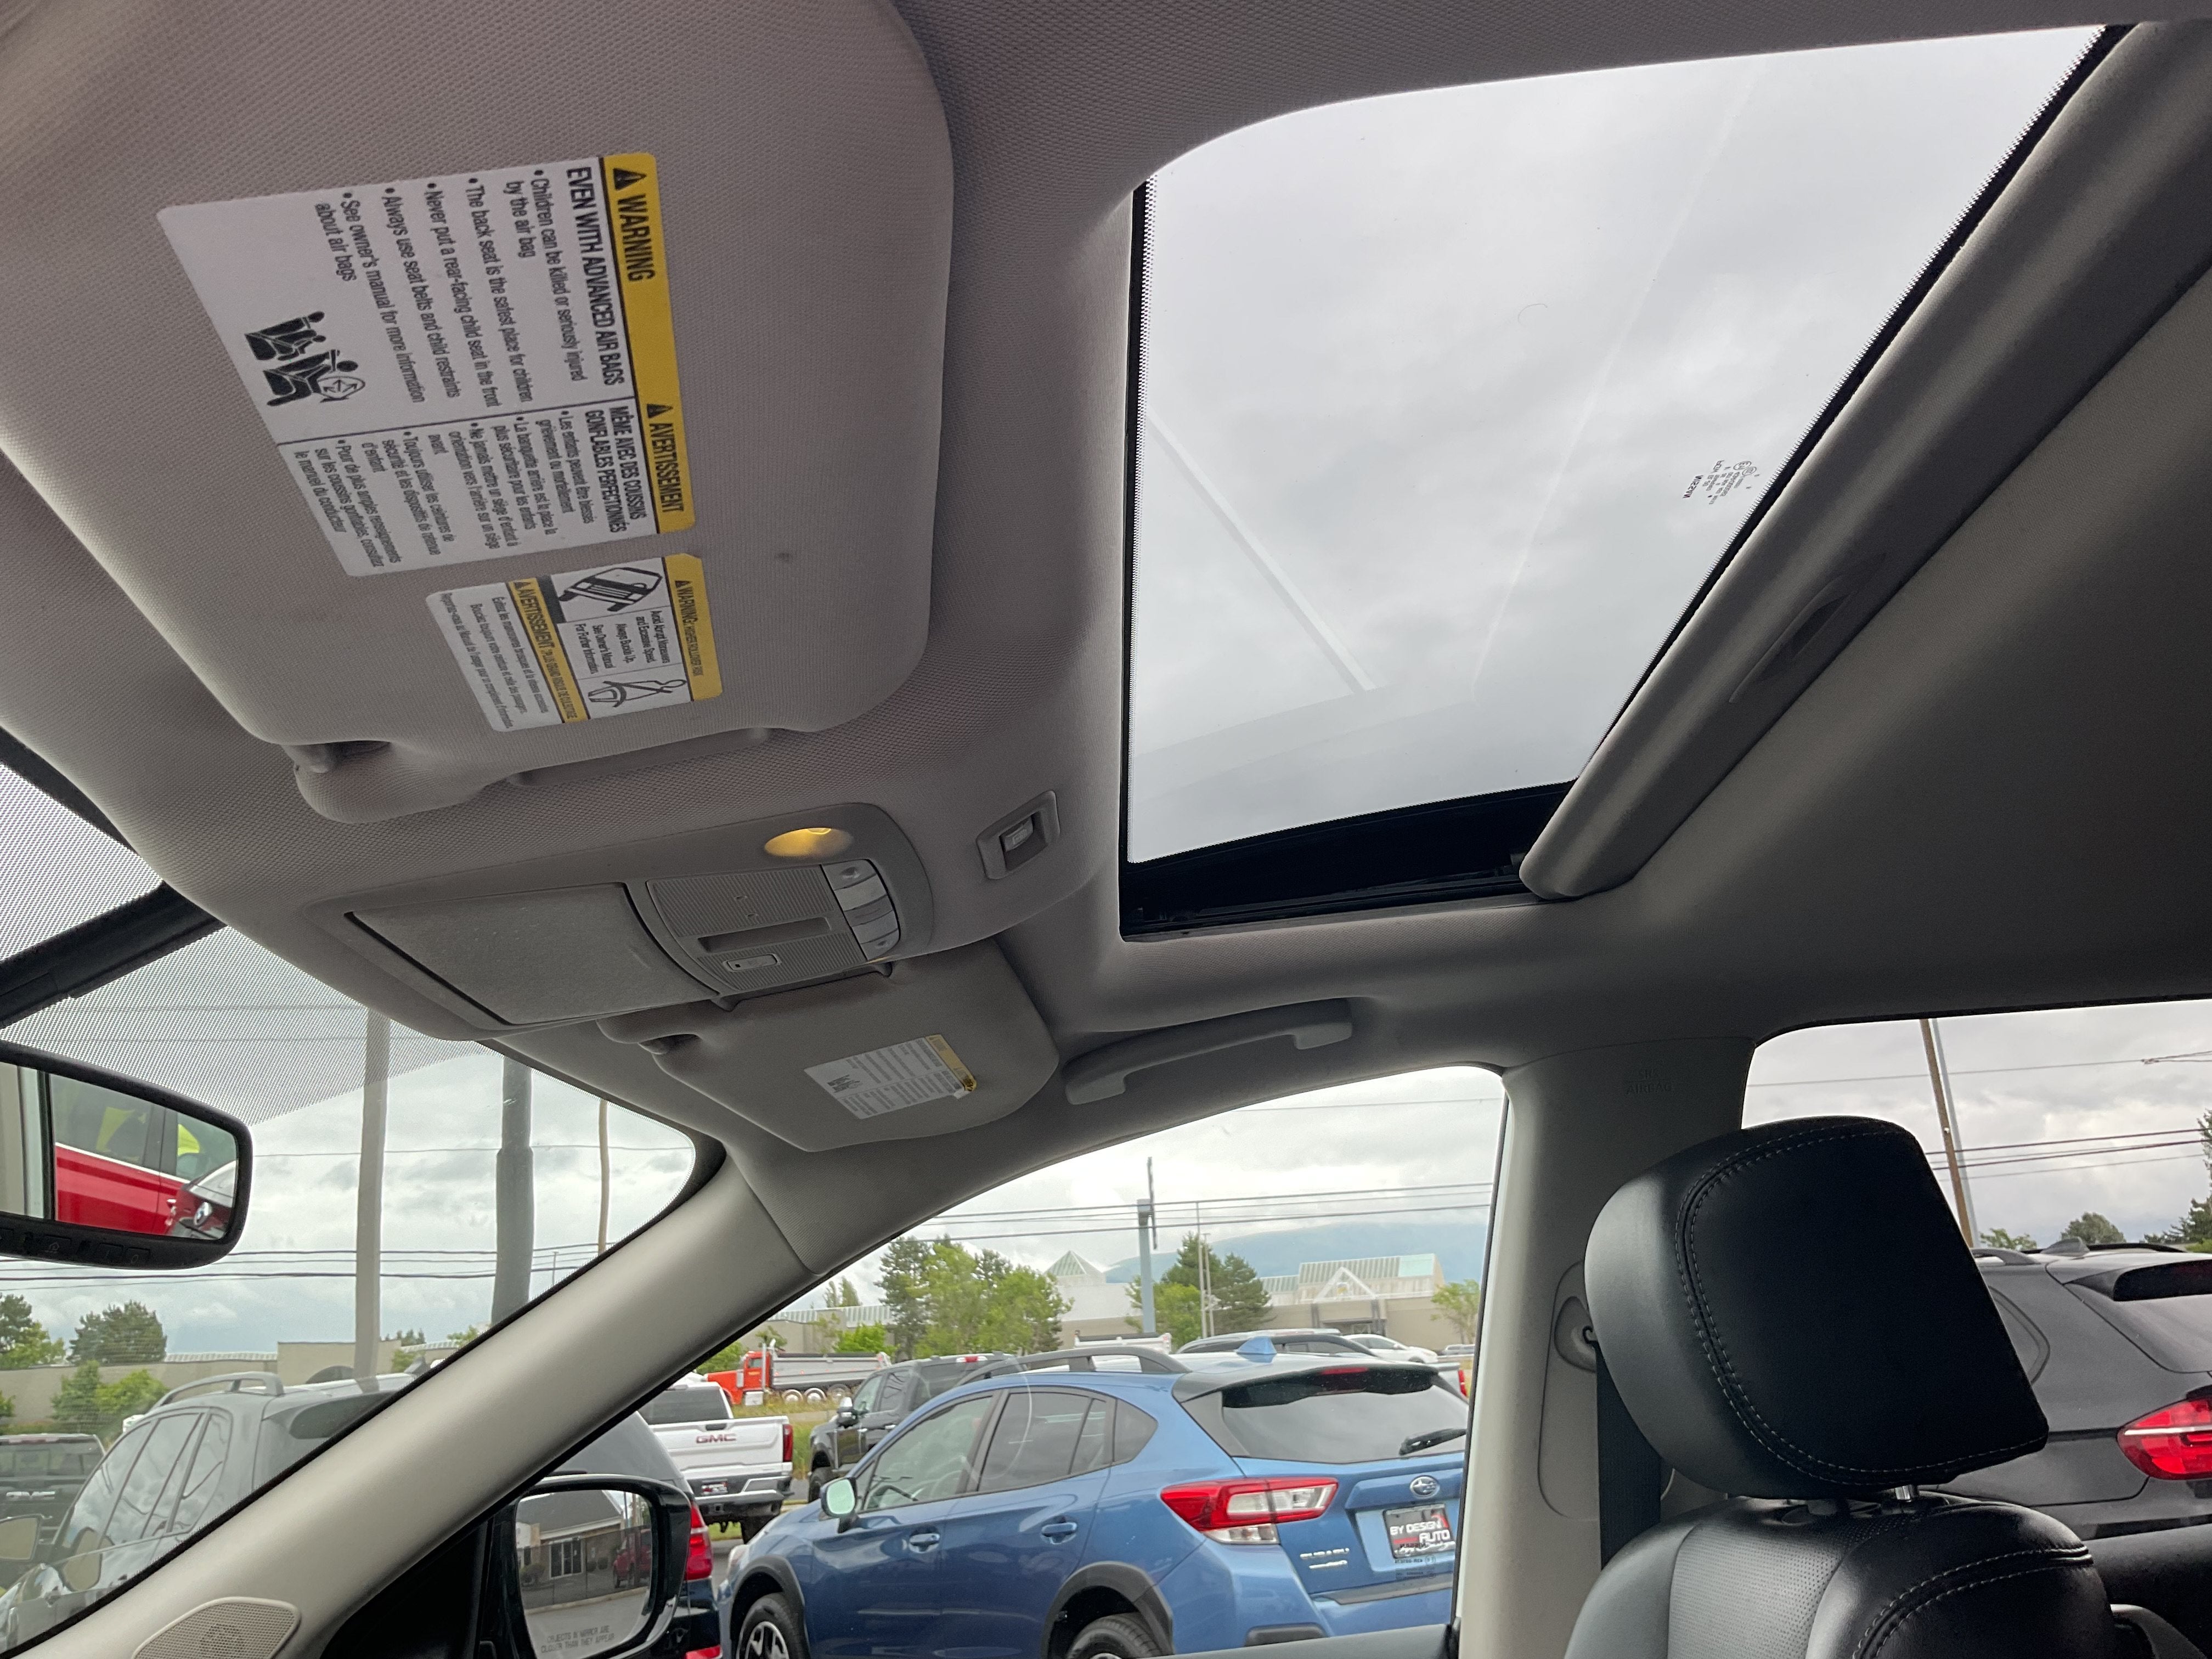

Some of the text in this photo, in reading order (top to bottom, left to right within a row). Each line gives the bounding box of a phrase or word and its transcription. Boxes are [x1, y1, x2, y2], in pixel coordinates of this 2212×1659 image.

[424, 190, 447, 224] Never
[503, 180, 536, 258] by the air bag
[314, 203, 357, 281] about air bags
[430, 226, 456, 246] put
[617, 194, 655, 281] WARNING
[443, 257, 472, 313] rear-facing
[530, 178, 588, 381] Children can be killed or seriously injured
[566, 166, 624, 385] EVEN WITH ADVANCED AIR BAGS
[340, 200, 425, 403] See owner's manual for more information
[381, 196, 460, 398] Always use seat belts and child restraints
[465, 185, 533, 402] The back seat is the safest place for children
[460, 315, 483, 338] child
[467, 340, 488, 360] seat
[474, 360, 490, 370] in
[477, 370, 493, 385] the
[482, 386, 501, 407] front
[469, 428, 484, 439] Ne
[513, 421, 529, 432] La
[314, 448, 331, 460] sur
[427, 434, 449, 455] avant
[469, 440, 493, 464] jamais
[516, 432, 538, 468] banquette
[536, 419, 562, 460] grièvement
[549, 460, 561, 470] ou
[321, 461, 337, 473] les
[361, 442, 386, 473] d'enfant
[558, 415, 594, 523] Les enfants peuvent être blessés
[609, 405, 647, 520] MÊME AVEC DES COUSSINS
[648, 422, 684, 512] AVERTISSEMENT
[481, 465, 498, 488] mettre
[491, 425, 536, 529] plus sécuritaire pour les enfants
[527, 469, 545, 492] arrière
[584, 410, 629, 533] GONFLABLES PERFECTIONNÉS
[294, 450, 347, 533] le manuel du conducteur
[327, 473, 352, 504] coussins
[381, 439, 441, 555] sécurité et les dispositifs de retenue
[402, 436, 454, 541] Toujours utiliser les ceintures de
[448, 431, 501, 549] orientation vers l'arrière sur un siège
[488, 488, 501, 496] un
[533, 492, 550, 504] est
[335, 445, 402, 563] Pour de plus amples renseignements
[492, 498, 508, 515] siège
[498, 516, 518, 542] d'enfant
[536, 510, 554, 528] place
[360, 539, 384, 567] consultez
[517, 589, 555, 648] AVERTISSEMENT
[574, 623, 586, 631] For
[635, 616, 648, 626] and
[577, 631, 591, 648] Further
[616, 623, 628, 640] Always
[637, 625, 651, 648] Excessive
[650, 610, 670, 663] Avoid Abrupt Maneuvers
[592, 624, 615, 669] See Owner's Manual
[619, 639, 634, 655] Buckle
[696, 1434, 737, 1444] GMC
[1390, 1520, 1442, 1536] BY DESIGN
[1419, 1529, 1450, 1543] AUTO
[541, 1633, 614, 1653] CLOSER THAN THEY APPEAR
[547, 1632, 571, 1643] OBJECTS
[600, 1625, 610, 1633] ARE
